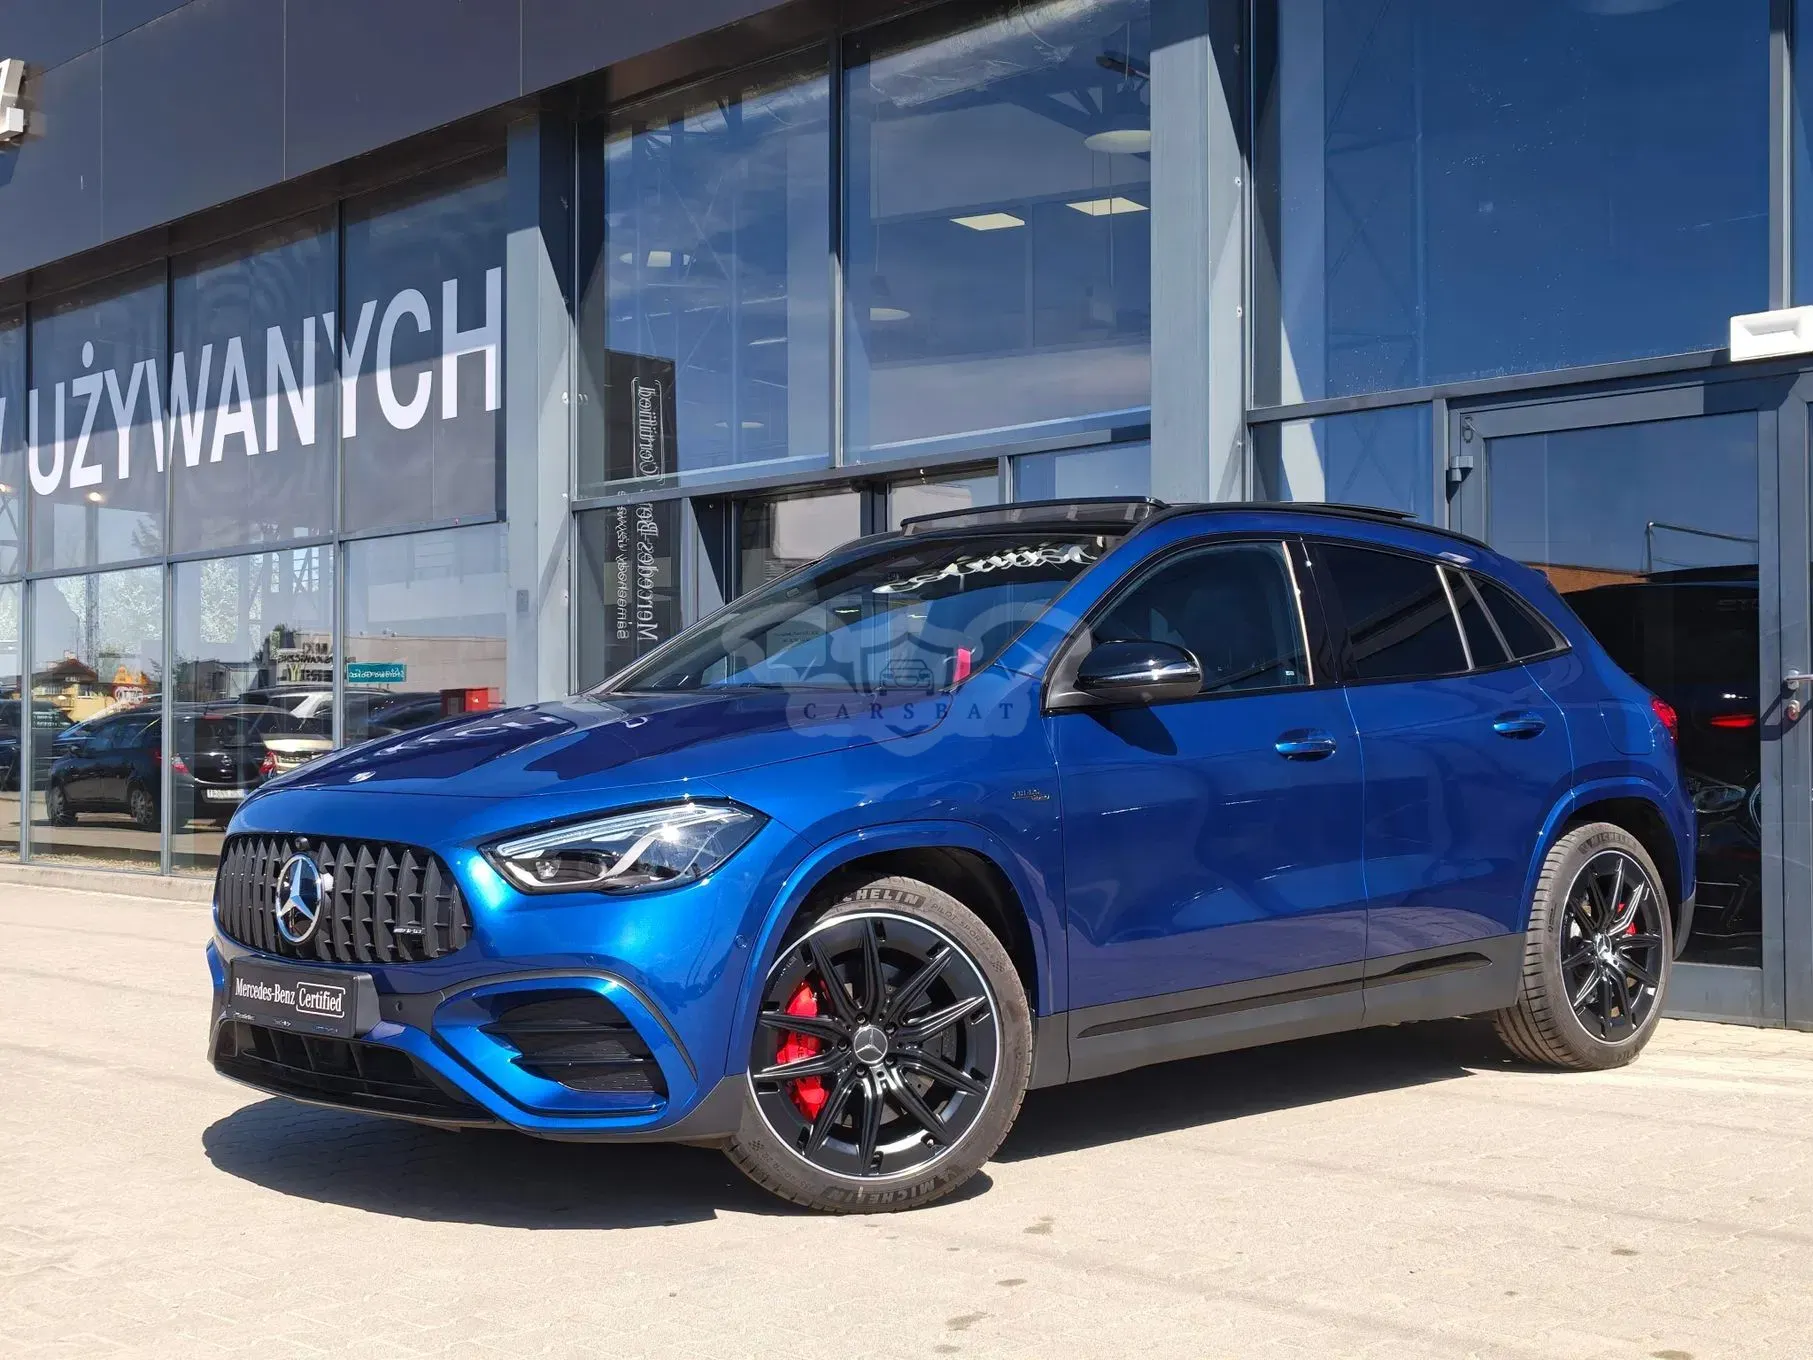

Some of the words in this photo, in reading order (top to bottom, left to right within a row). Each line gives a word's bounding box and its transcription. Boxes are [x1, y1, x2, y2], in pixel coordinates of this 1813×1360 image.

[29, 267, 501, 495] UŻYWANYCH
[235, 978, 296, 1005] Mercedes-Benz
[299, 988, 342, 1012] Certified
